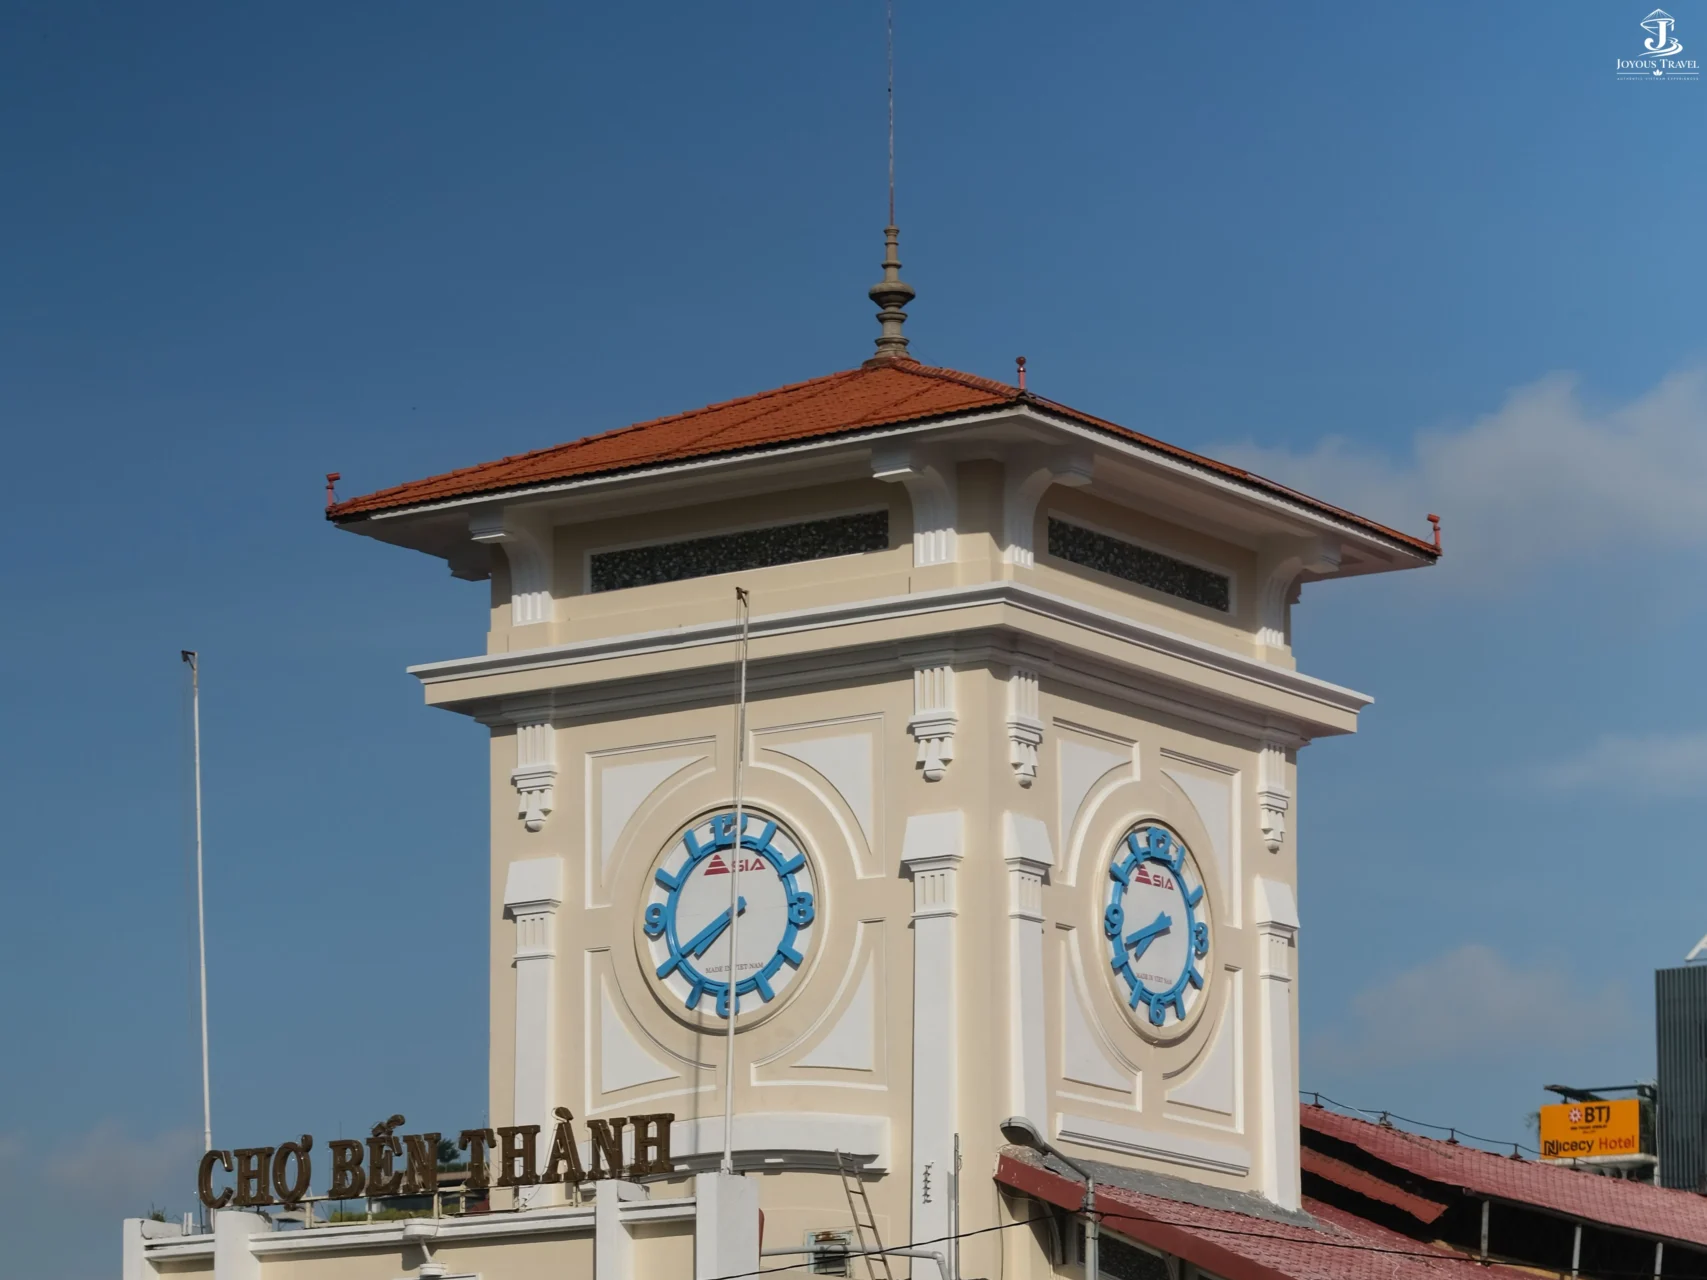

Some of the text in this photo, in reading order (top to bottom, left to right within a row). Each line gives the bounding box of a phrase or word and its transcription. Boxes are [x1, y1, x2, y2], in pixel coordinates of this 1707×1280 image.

[1146, 826, 1172, 862] 12
[644, 903, 668, 935] 9
[790, 892, 815, 924] 3
[1105, 904, 1124, 936] 9
[1195, 922, 1209, 953] 3
[1149, 994, 1166, 1026] 6
[1585, 1105, 1610, 1124] BTJ
[199, 1106, 675, 1210] CHỢ BẾN THÀNH
[1599, 1135, 1635, 1151] Hotel
